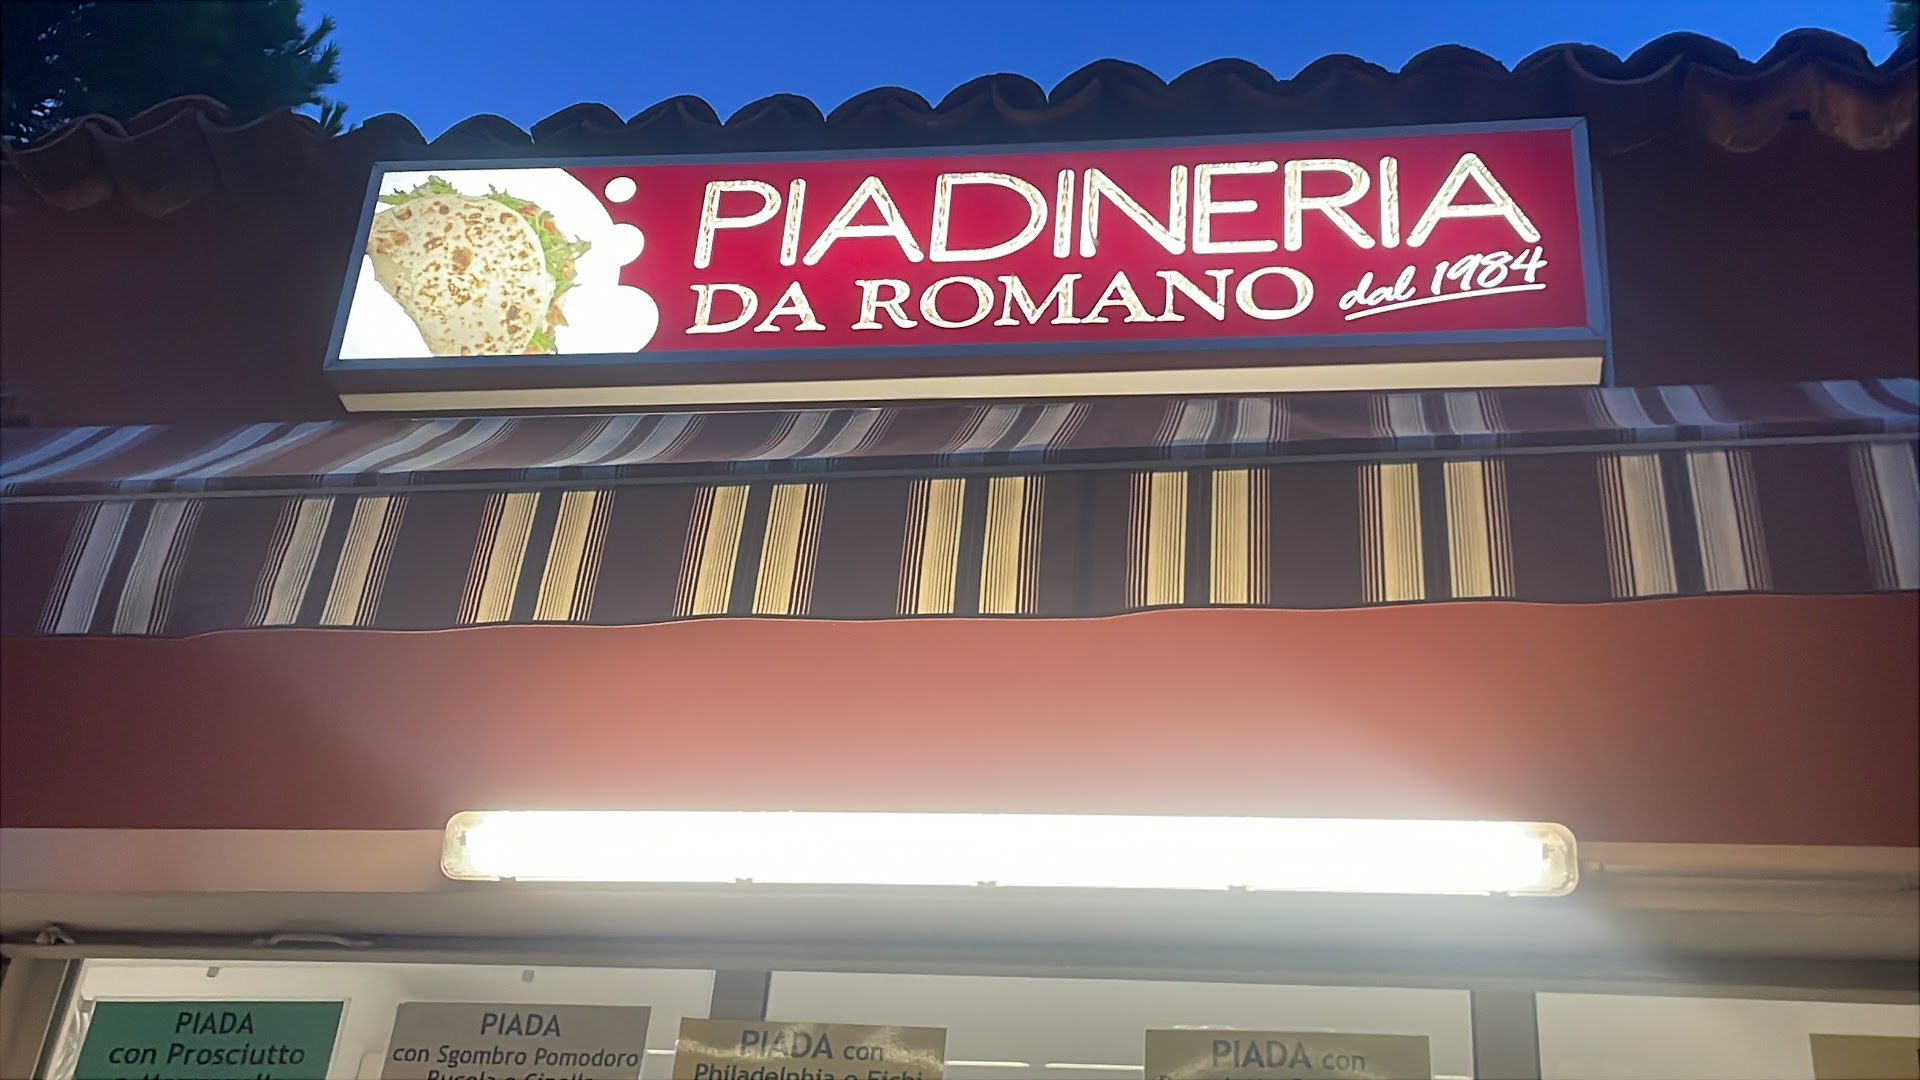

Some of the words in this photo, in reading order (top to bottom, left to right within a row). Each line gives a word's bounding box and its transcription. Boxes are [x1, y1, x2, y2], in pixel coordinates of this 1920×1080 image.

[693, 153, 1542, 271] PIADINERIA
[1338, 265, 1417, 310] dal
[1430, 245, 1548, 296] 1984
[686, 281, 826, 333] DA
[851, 267, 1314, 330] ROMANO
[174, 1011, 254, 1035] PIADA
[480, 1012, 561, 1037] PIADA
[108, 1046, 157, 1065] con
[166, 1043, 306, 1065] Prosciutto
[392, 1047, 430, 1062] con
[436, 1045, 527, 1068] Sgombro
[534, 1047, 639, 1068] Pomodoro
[740, 1029, 834, 1060] PIADA
[843, 1044, 884, 1061] con
[1211, 1039, 1312, 1069] PIADA
[1322, 1052, 1366, 1071] con
